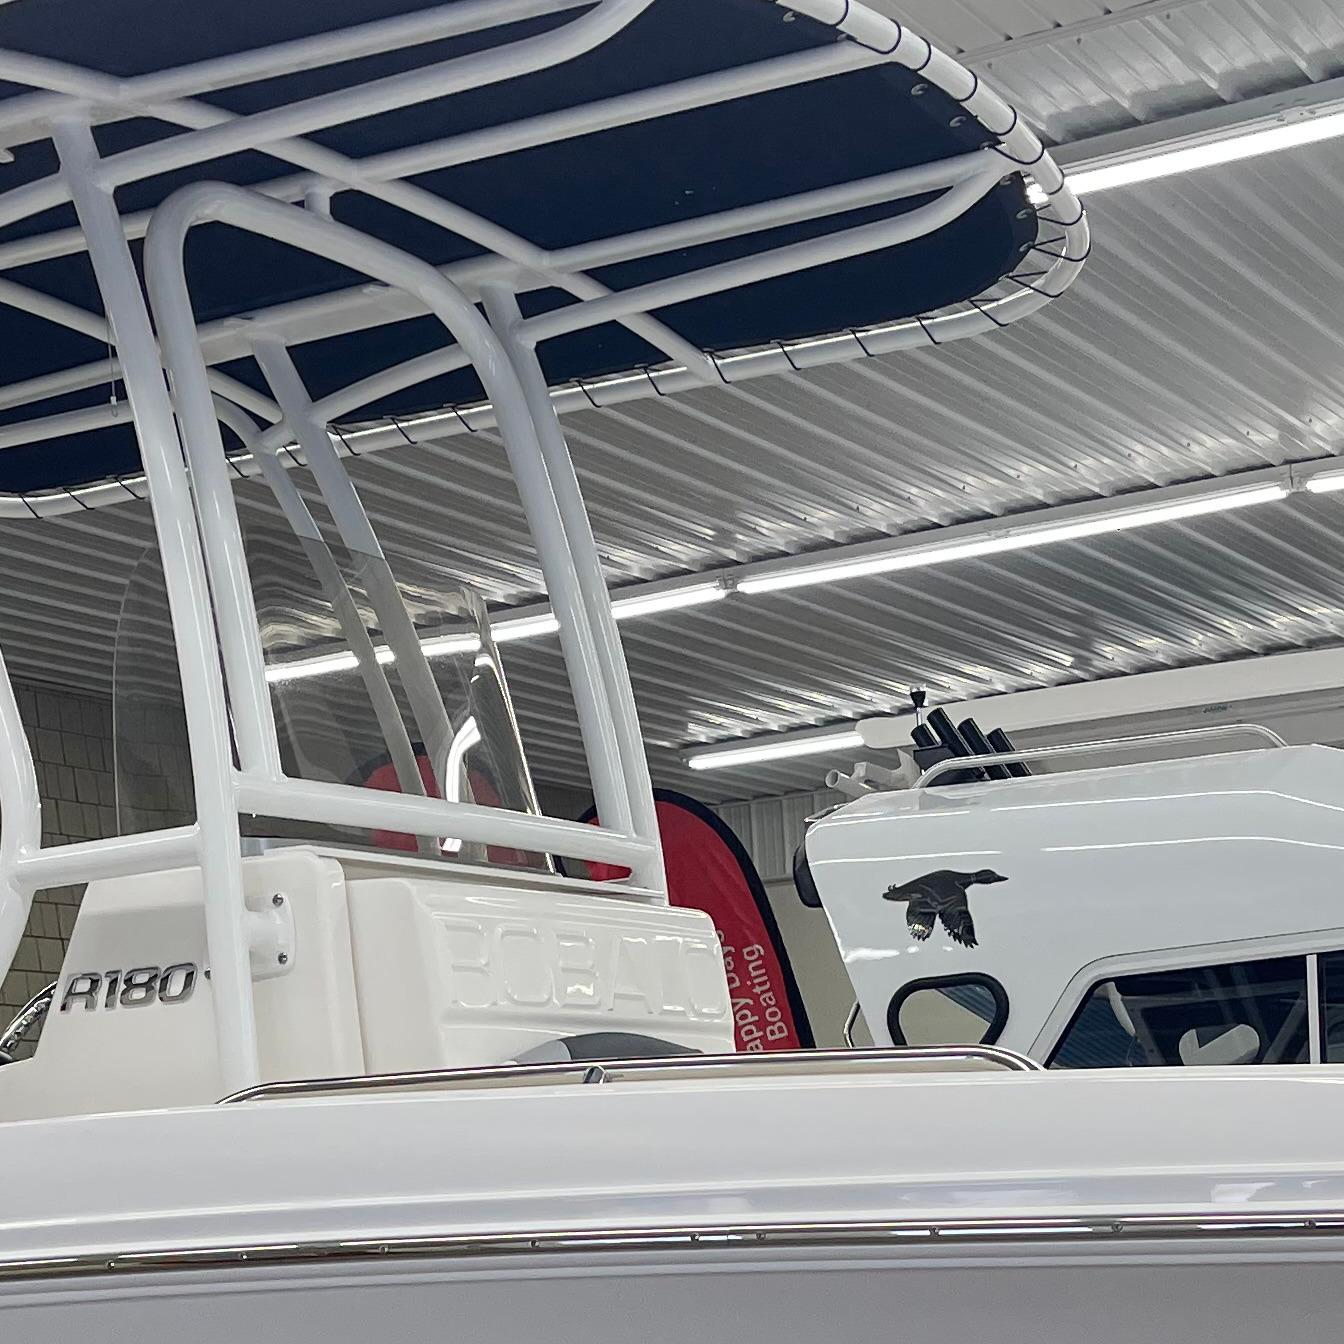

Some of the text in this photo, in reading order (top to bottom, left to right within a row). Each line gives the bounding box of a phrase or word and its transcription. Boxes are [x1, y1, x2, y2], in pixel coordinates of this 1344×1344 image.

[60, 962, 197, 1013] R180
[742, 944, 788, 1041] Boating
[730, 998, 764, 1052] appy
